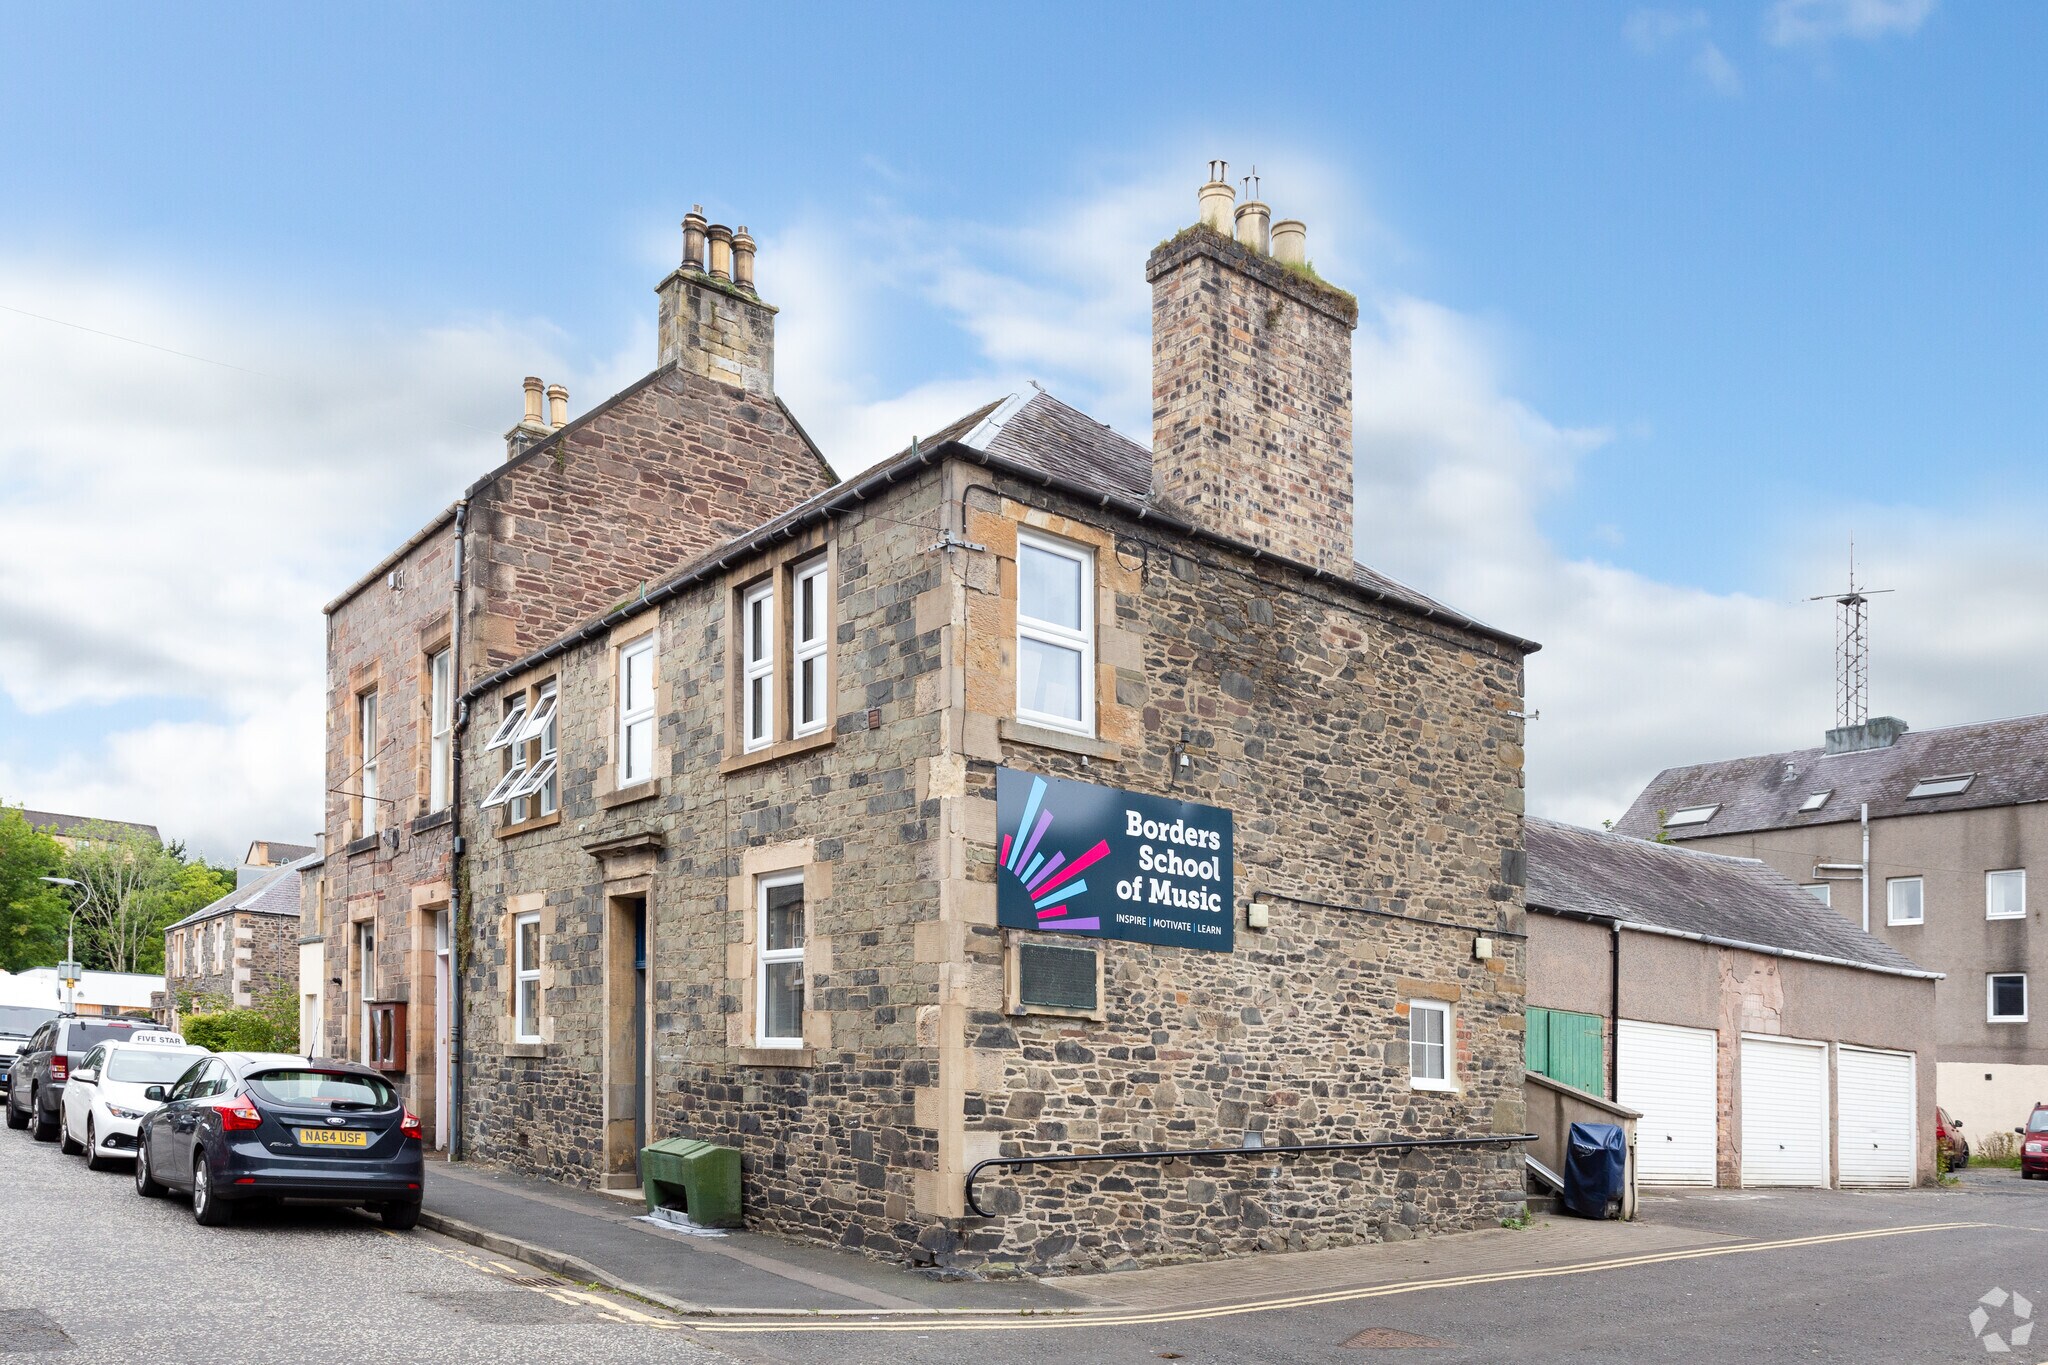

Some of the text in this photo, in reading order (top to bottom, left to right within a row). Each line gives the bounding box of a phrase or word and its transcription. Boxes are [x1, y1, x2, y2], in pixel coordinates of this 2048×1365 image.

[1125, 809, 1221, 851] Borders
[1139, 844, 1221, 882] School
[1116, 875, 1222, 912] of Music
[1116, 913, 1222, 935] INSPIRE MOTIVATE LEARN
[305, 1131, 362, 1143] NA64 USF
